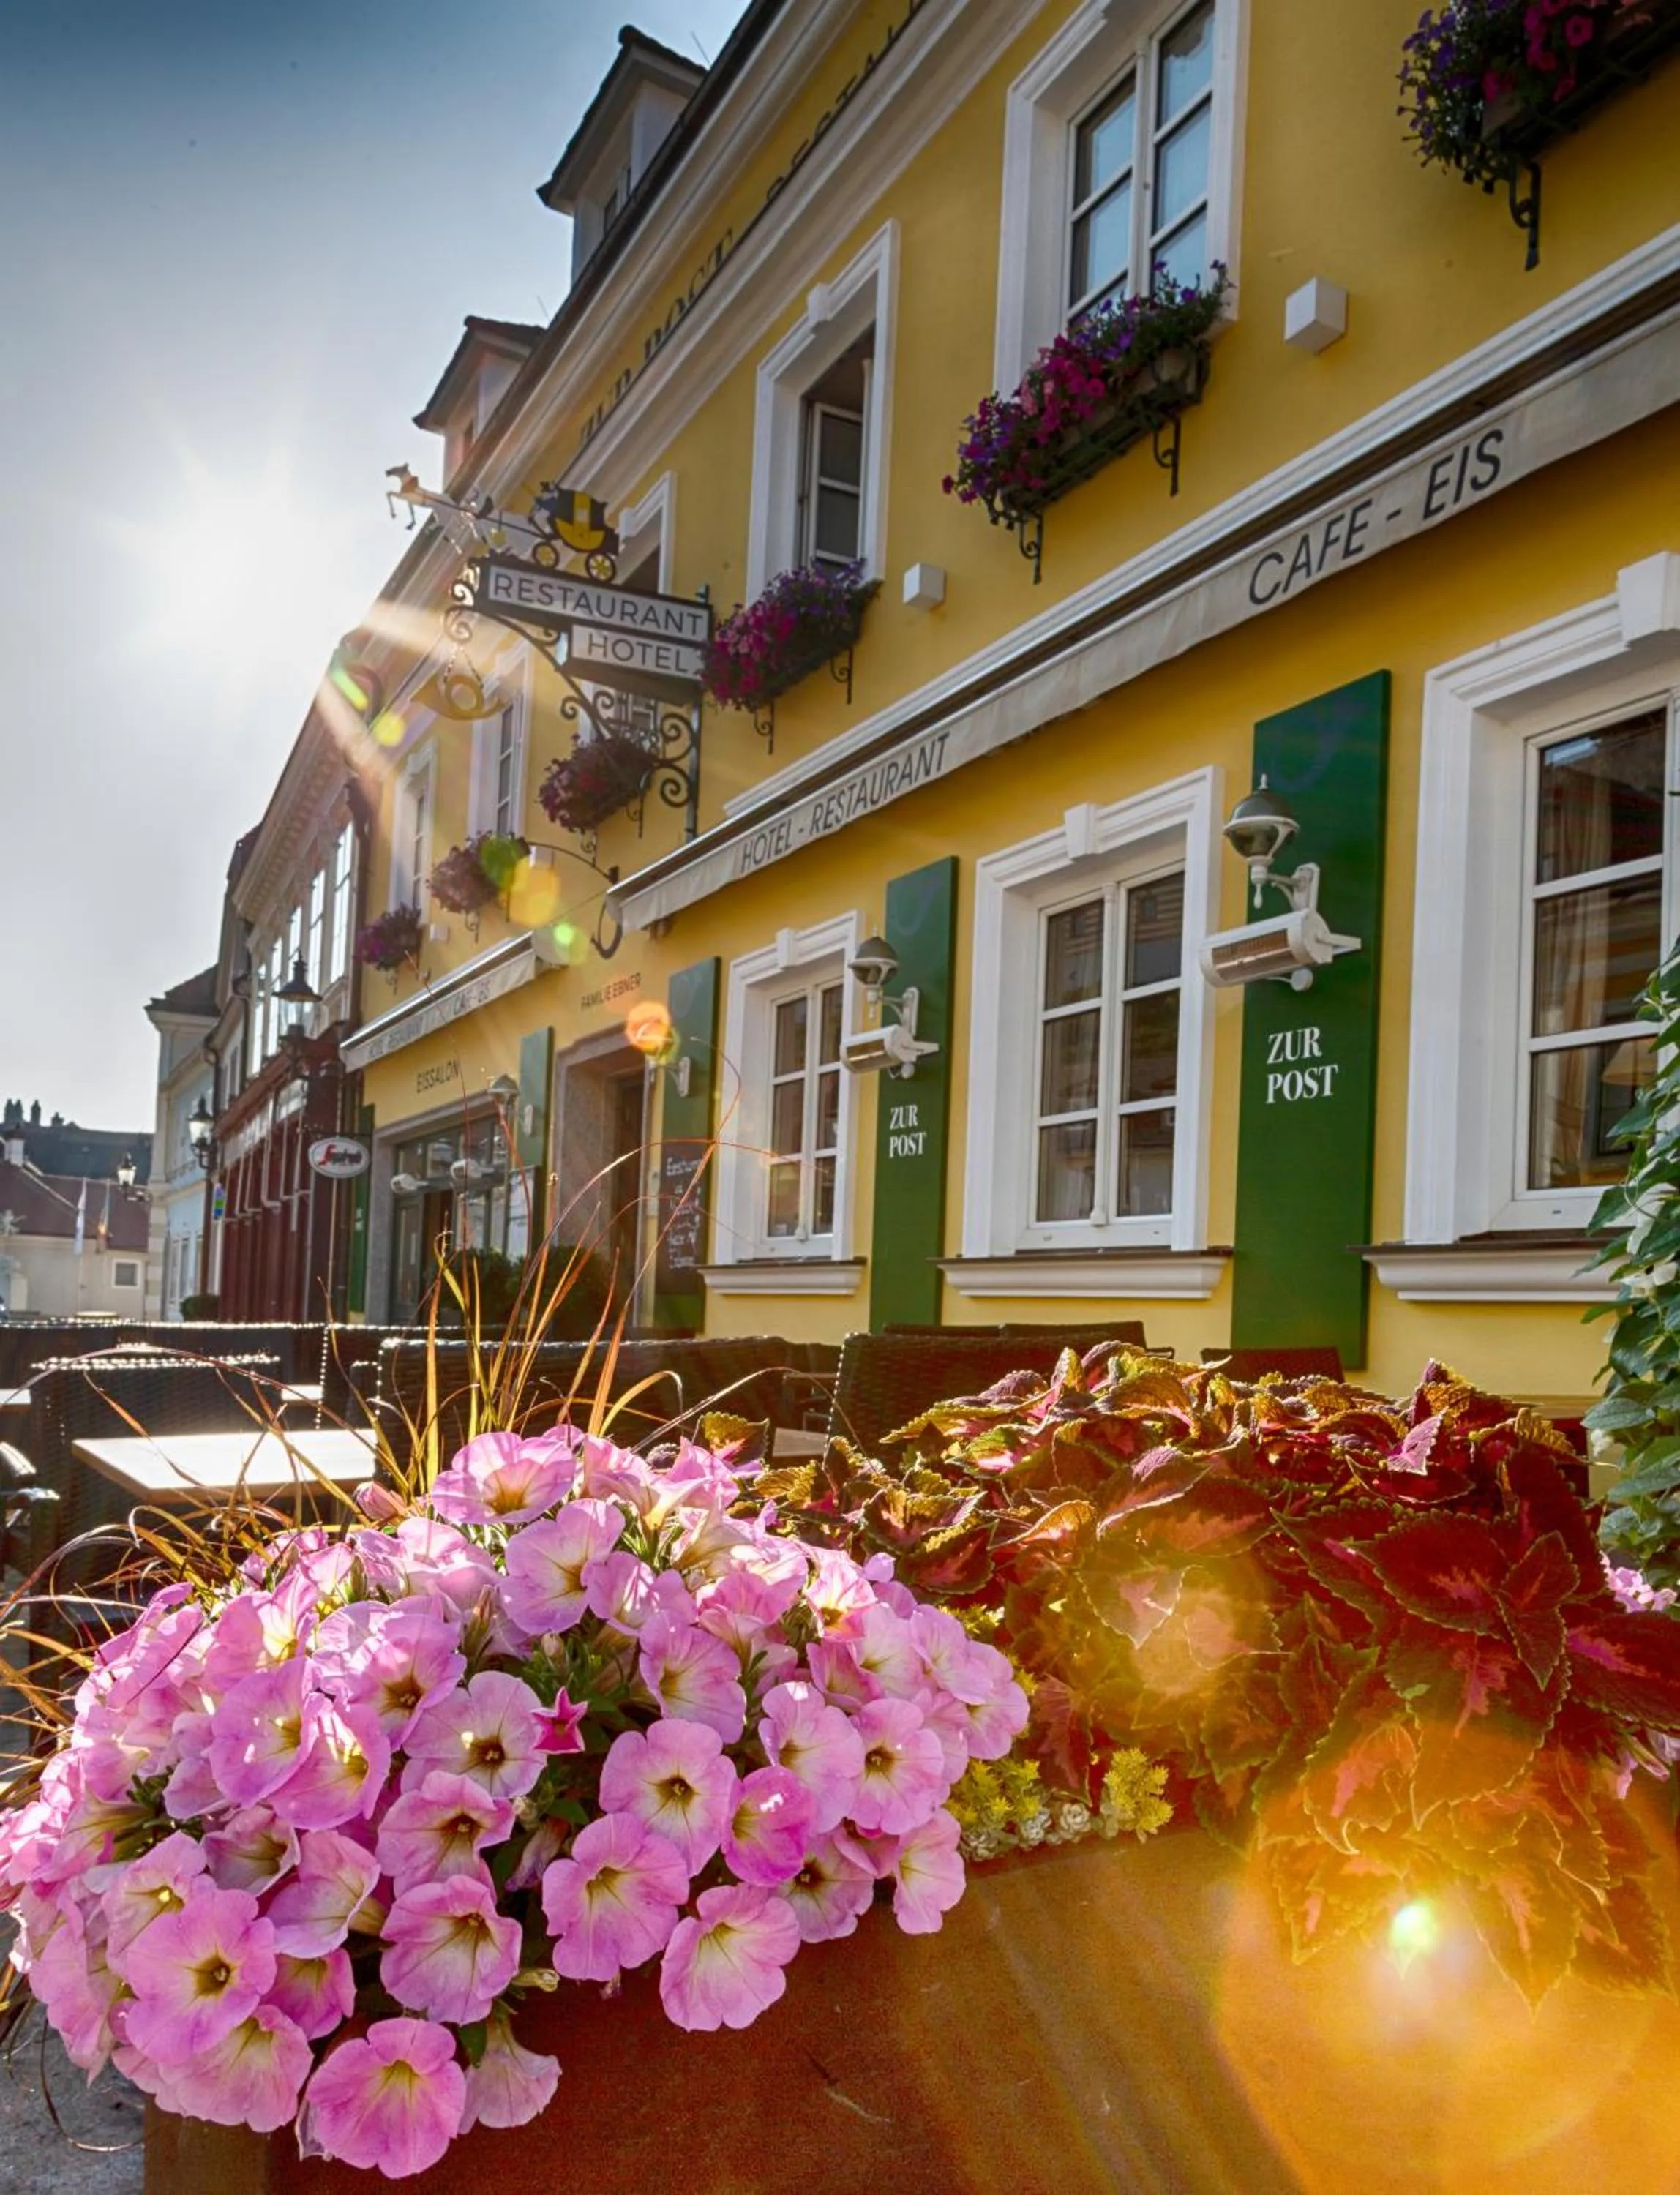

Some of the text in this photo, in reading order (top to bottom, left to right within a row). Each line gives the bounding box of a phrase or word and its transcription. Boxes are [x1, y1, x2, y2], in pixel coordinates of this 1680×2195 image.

[1249, 499, 1373, 604] CAFE
[1422, 429, 1504, 519] EIS
[493, 572, 704, 636] RESTAURANT
[588, 634, 688, 673] HOTEL
[740, 819, 792, 873] HOTEL
[809, 732, 950, 836] RESTAURANT
[1267, 1026, 1323, 1065] ZUR
[416, 1059, 460, 1094] EISSALON
[1266, 1063, 1338, 1104] POST
[889, 1103, 918, 1130] ZUR
[889, 1130, 927, 1158] POST
